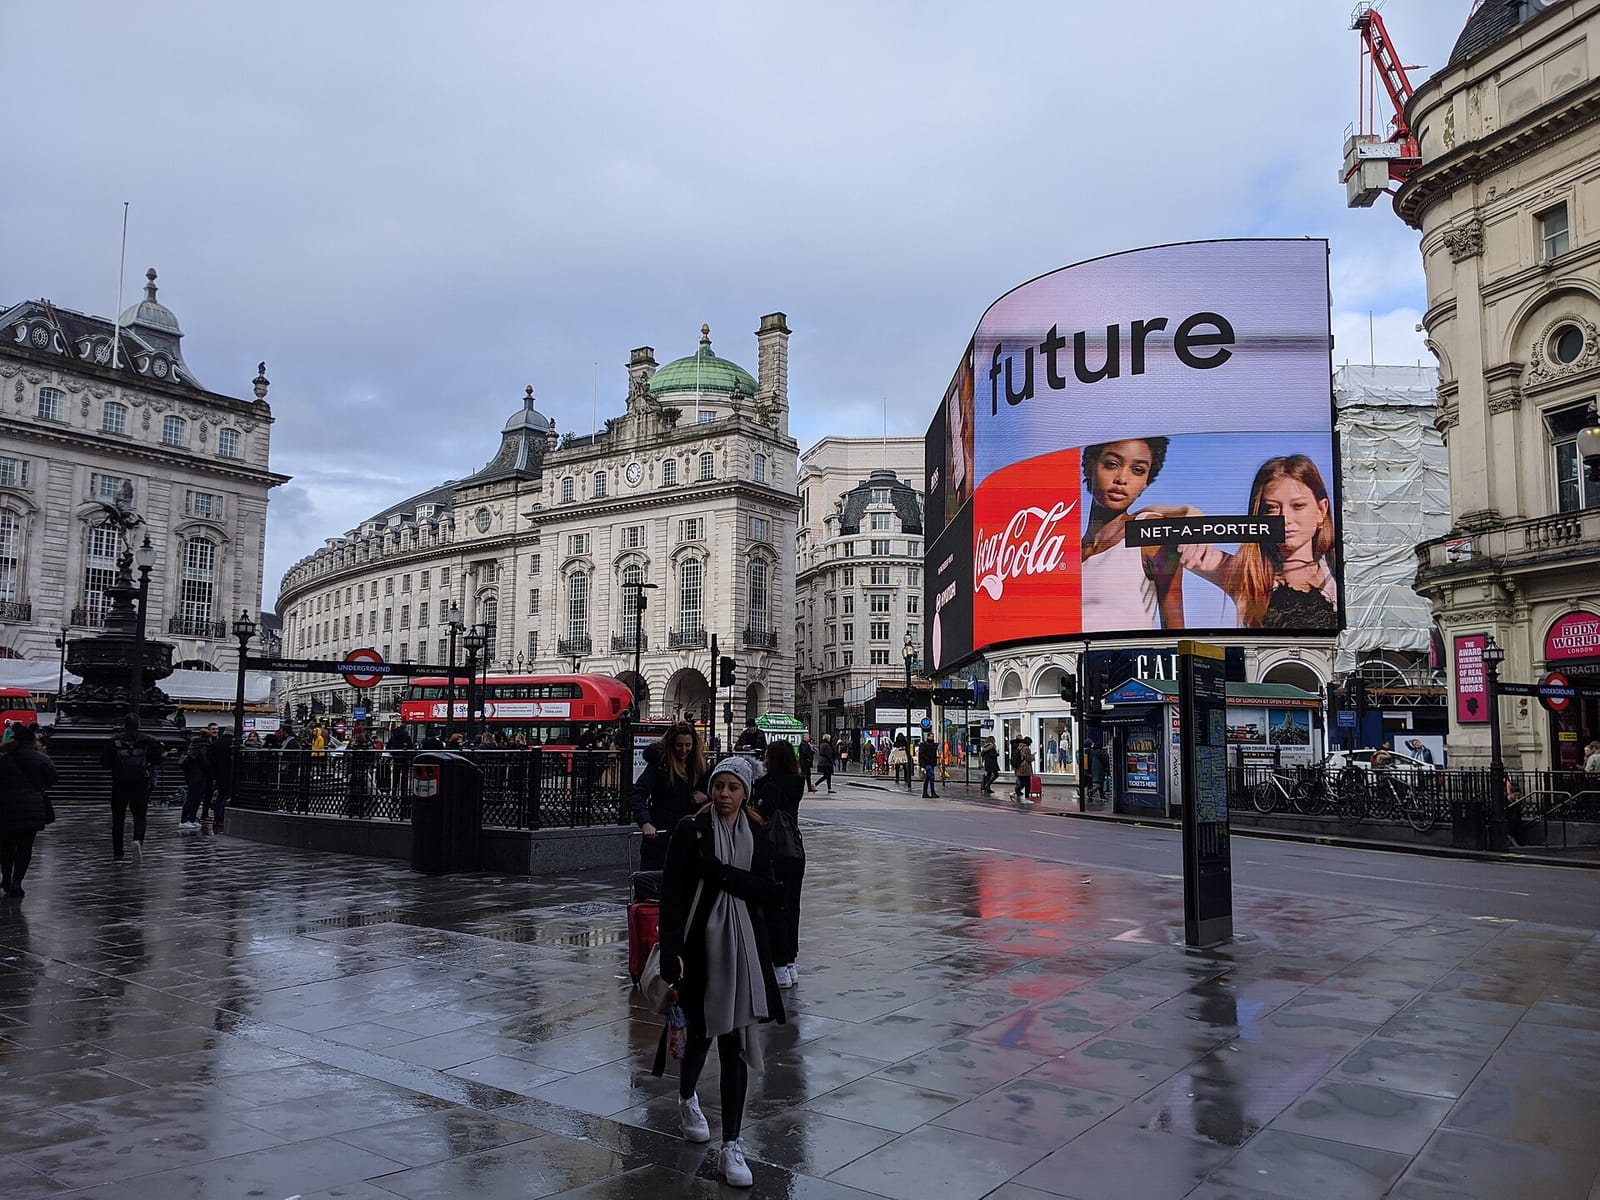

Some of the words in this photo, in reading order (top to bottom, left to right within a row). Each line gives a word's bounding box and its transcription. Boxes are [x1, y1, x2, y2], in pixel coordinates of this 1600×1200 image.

[989, 312, 1236, 417] future
[1140, 523, 1271, 539] NET-A-PORTER
[974, 498, 1078, 601] Coca-Cola
[1561, 623, 1599, 637] BODY
[1459, 648, 1482, 657] AWARD
[1567, 647, 1593, 655] LONDON
[337, 664, 391, 674] UNDERGROUND
[1468, 668, 1482, 676] REAL
[1460, 676, 1483, 684] HUMAN
[1460, 684, 1484, 693] BODIES
[1539, 687, 1575, 696] UNDERGROUND
